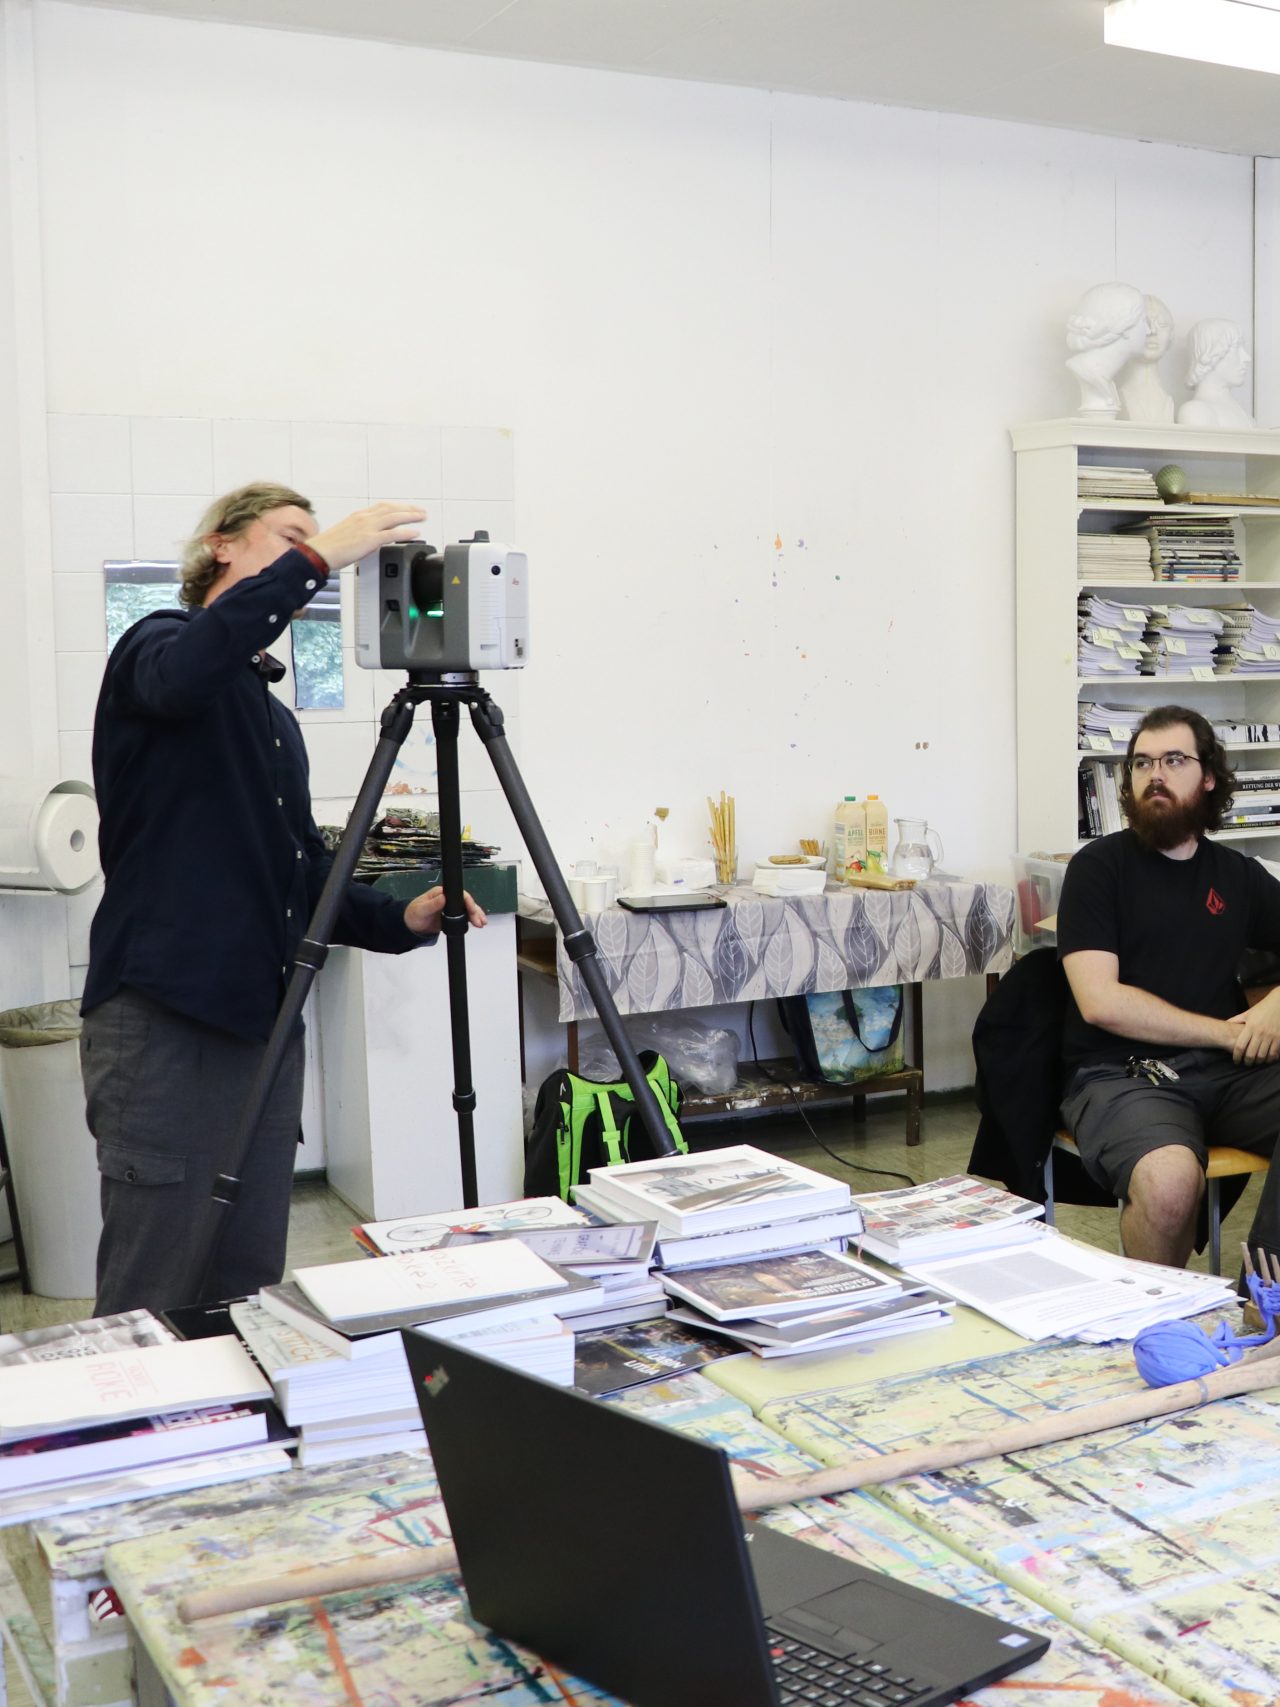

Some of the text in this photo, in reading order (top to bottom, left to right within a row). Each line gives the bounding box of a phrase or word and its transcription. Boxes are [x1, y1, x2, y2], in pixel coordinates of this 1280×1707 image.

[1242, 782, 1264, 790] RETTUNG
[848, 829, 864, 837] APFEL
[868, 827, 886, 836] BIRNE
[645, 1165, 793, 1197] WEAVING
[85, 1361, 133, 1402] ROKE
